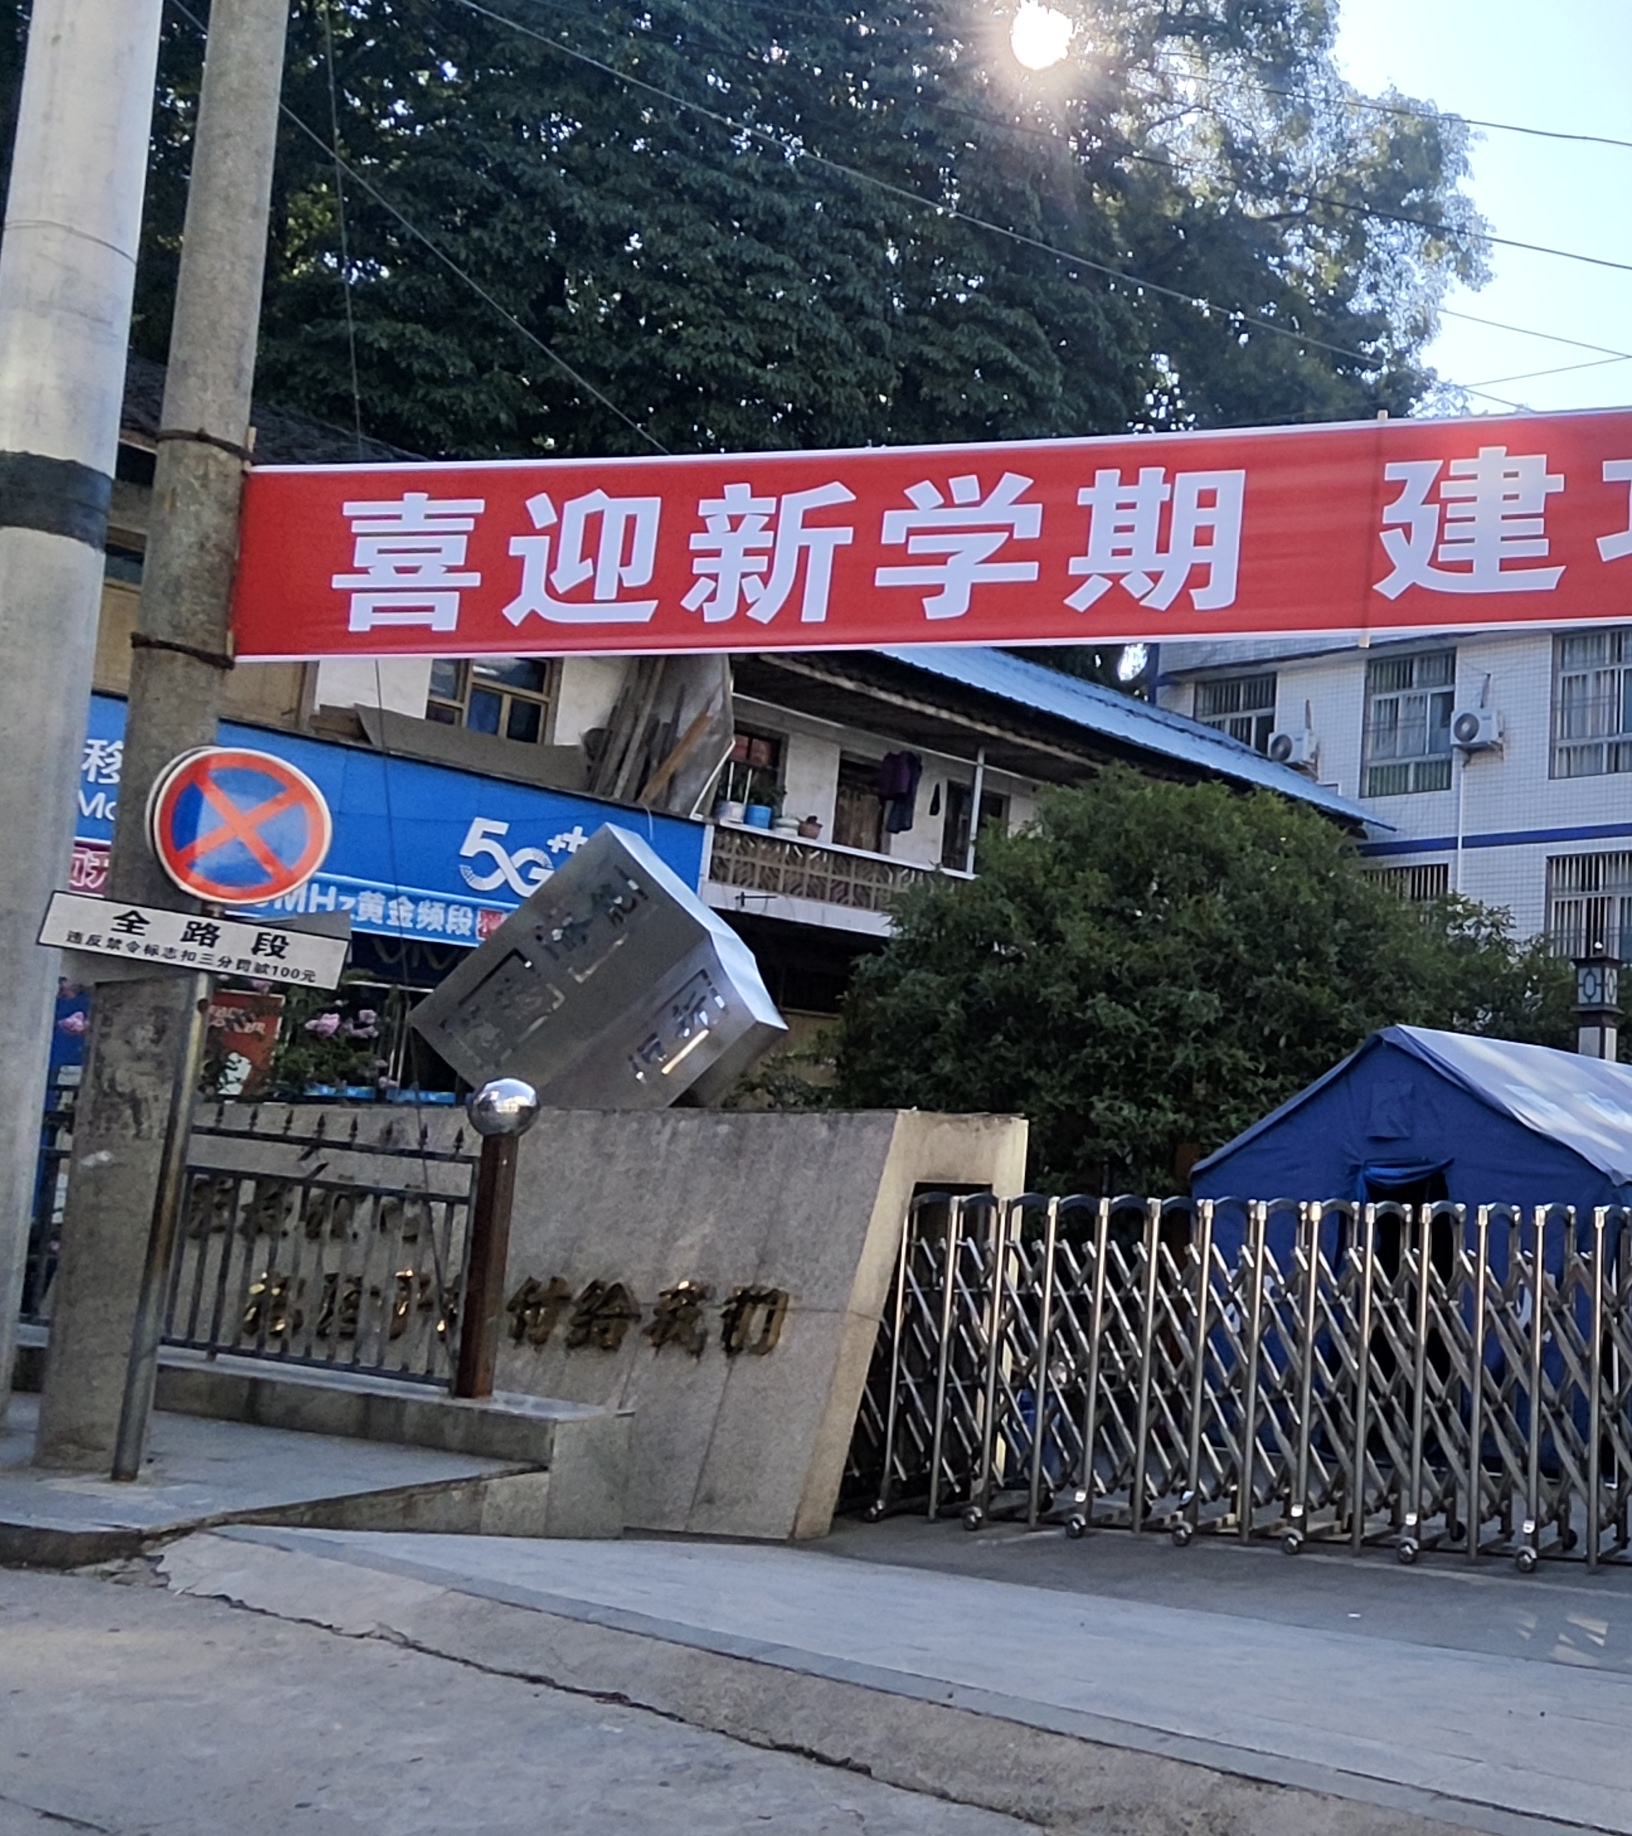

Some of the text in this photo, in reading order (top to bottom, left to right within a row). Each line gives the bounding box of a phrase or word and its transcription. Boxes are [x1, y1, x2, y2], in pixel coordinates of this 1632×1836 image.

[329, 466, 1248, 633] 喜迎新学期
[110, 909, 290, 960] 全路段
[254, 882, 474, 937] MHz黄金频段
